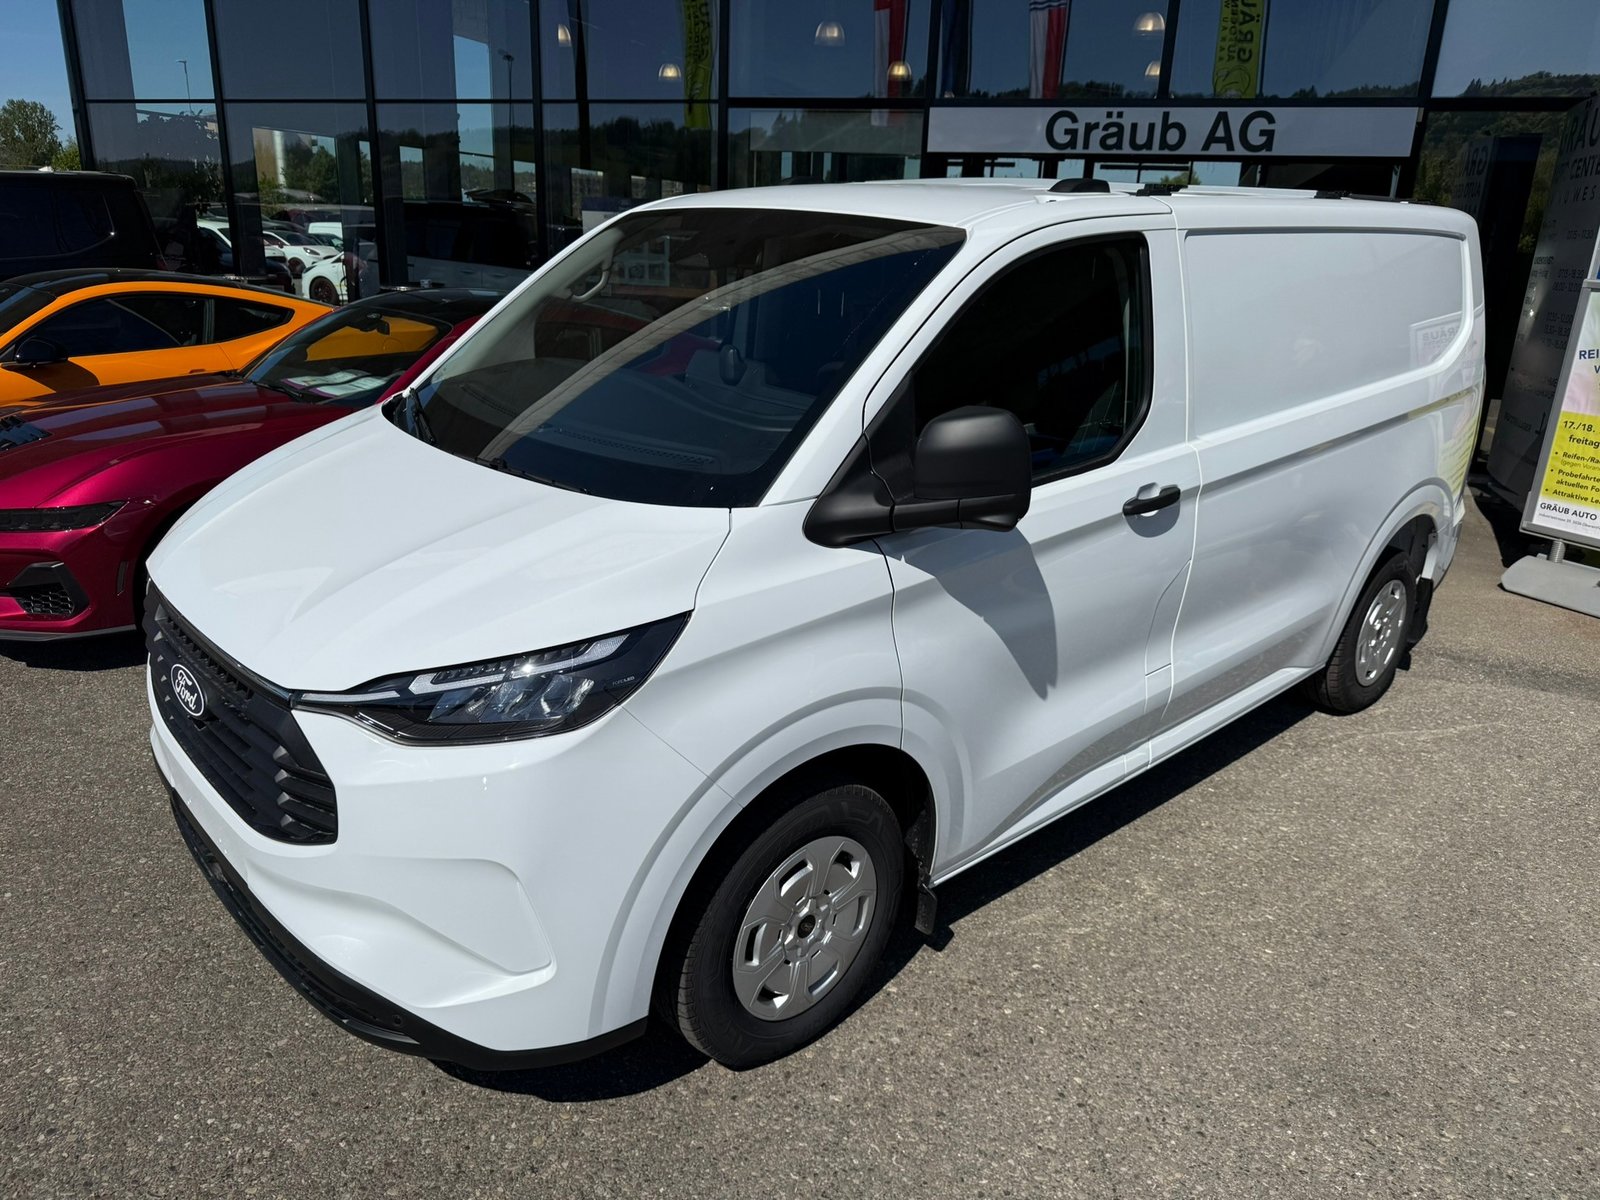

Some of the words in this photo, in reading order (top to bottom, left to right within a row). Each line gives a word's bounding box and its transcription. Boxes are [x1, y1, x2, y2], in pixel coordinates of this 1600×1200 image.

[1045, 110, 1187, 151] Gräub
[1201, 110, 1277, 153] AG
[1563, 421, 1595, 432] 17./18.
[1556, 479, 1588, 490] aktuellen
[1552, 488, 1588, 502] Attraktive
[1540, 502, 1570, 515] GRÄUB
[1571, 510, 1597, 521] AUTO
[175, 669, 197, 711] Ford
